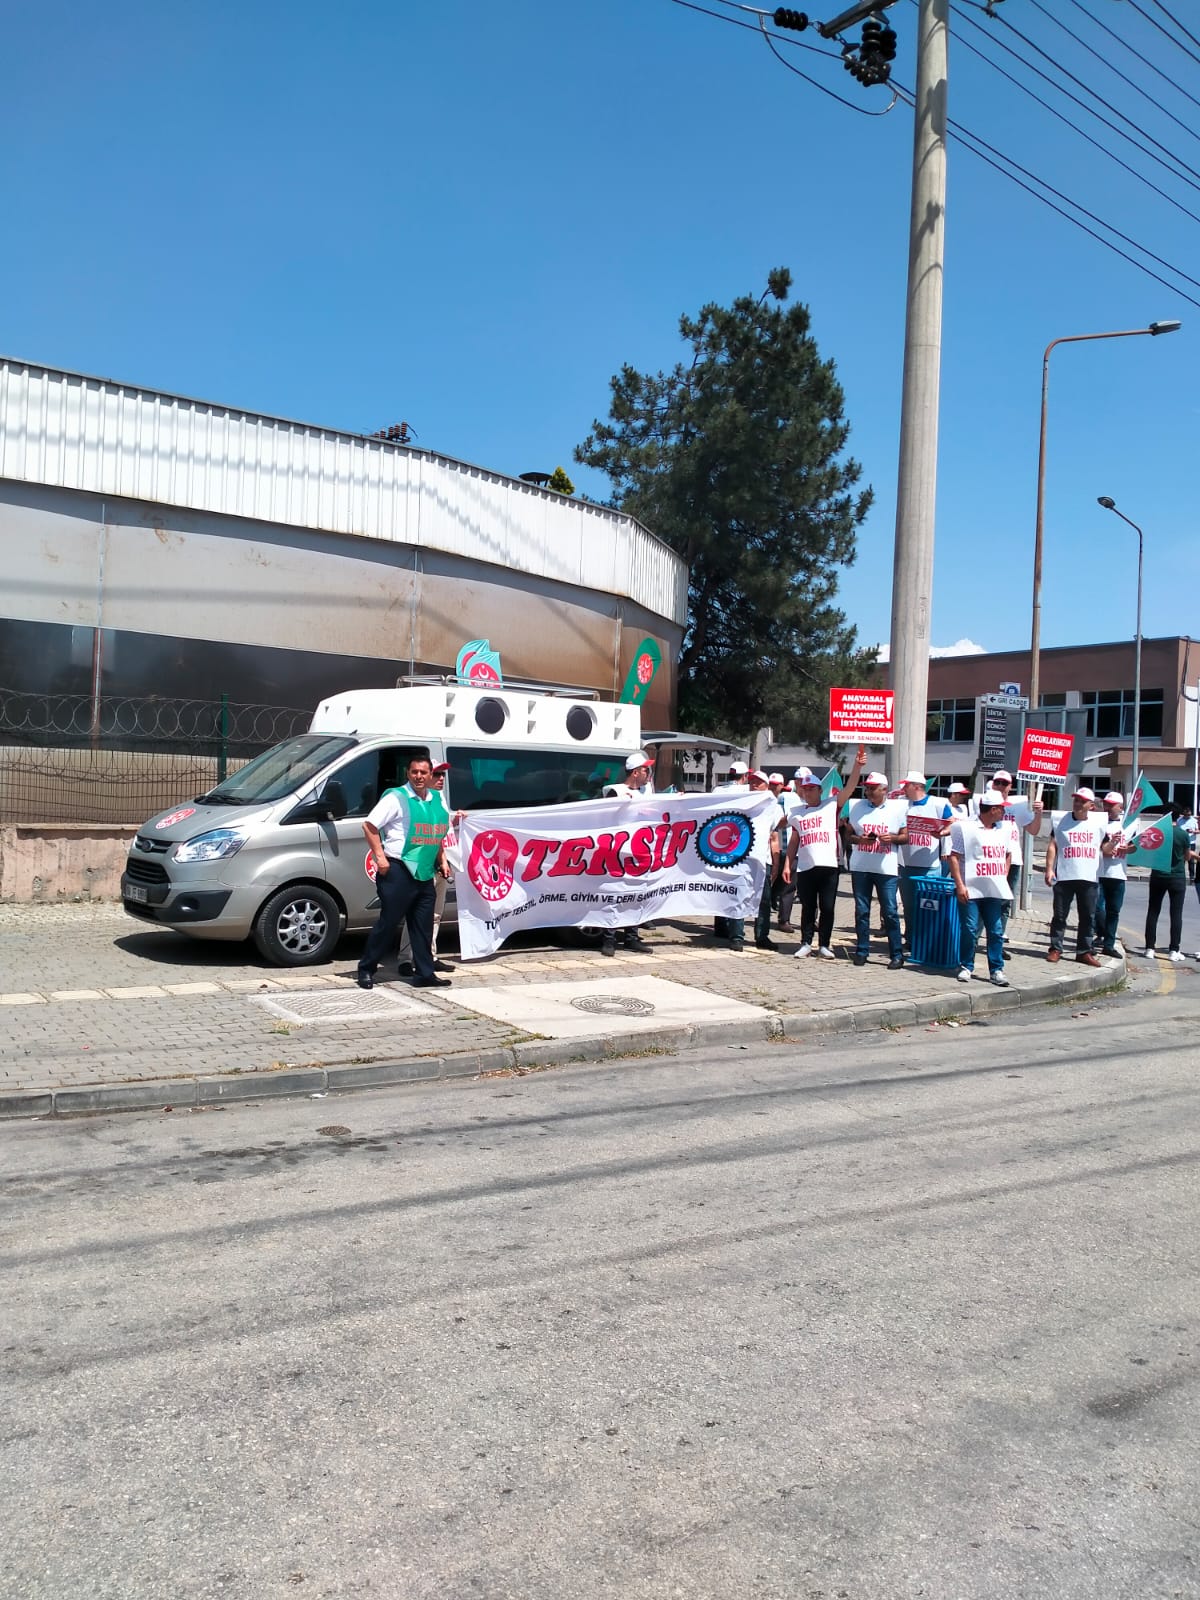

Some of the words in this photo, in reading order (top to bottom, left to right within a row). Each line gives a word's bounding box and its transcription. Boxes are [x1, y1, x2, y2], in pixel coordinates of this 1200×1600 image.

[842, 694, 885, 703] ANAYASAL
[843, 703, 885, 711] HAKKIMIZ
[832, 711, 885, 720] KULLANMAK
[840, 719, 885, 729] İSTİYORUZ
[1018, 772, 1038, 781] TEKSİF
[1038, 774, 1066, 785] SENDİKASI
[798, 815, 823, 831] TEKSİF
[799, 830, 830, 849] ENDİKASI
[1068, 829, 1094, 844] TEKSİF
[521, 812, 697, 882] TEKSİF
[538, 892, 568, 904] ÖRME,
[570, 891, 599, 903] GİYİM
[601, 894, 614, 903] VE
[616, 892, 636, 904] DERİ
[688, 882, 738, 896] SENDİKASI
